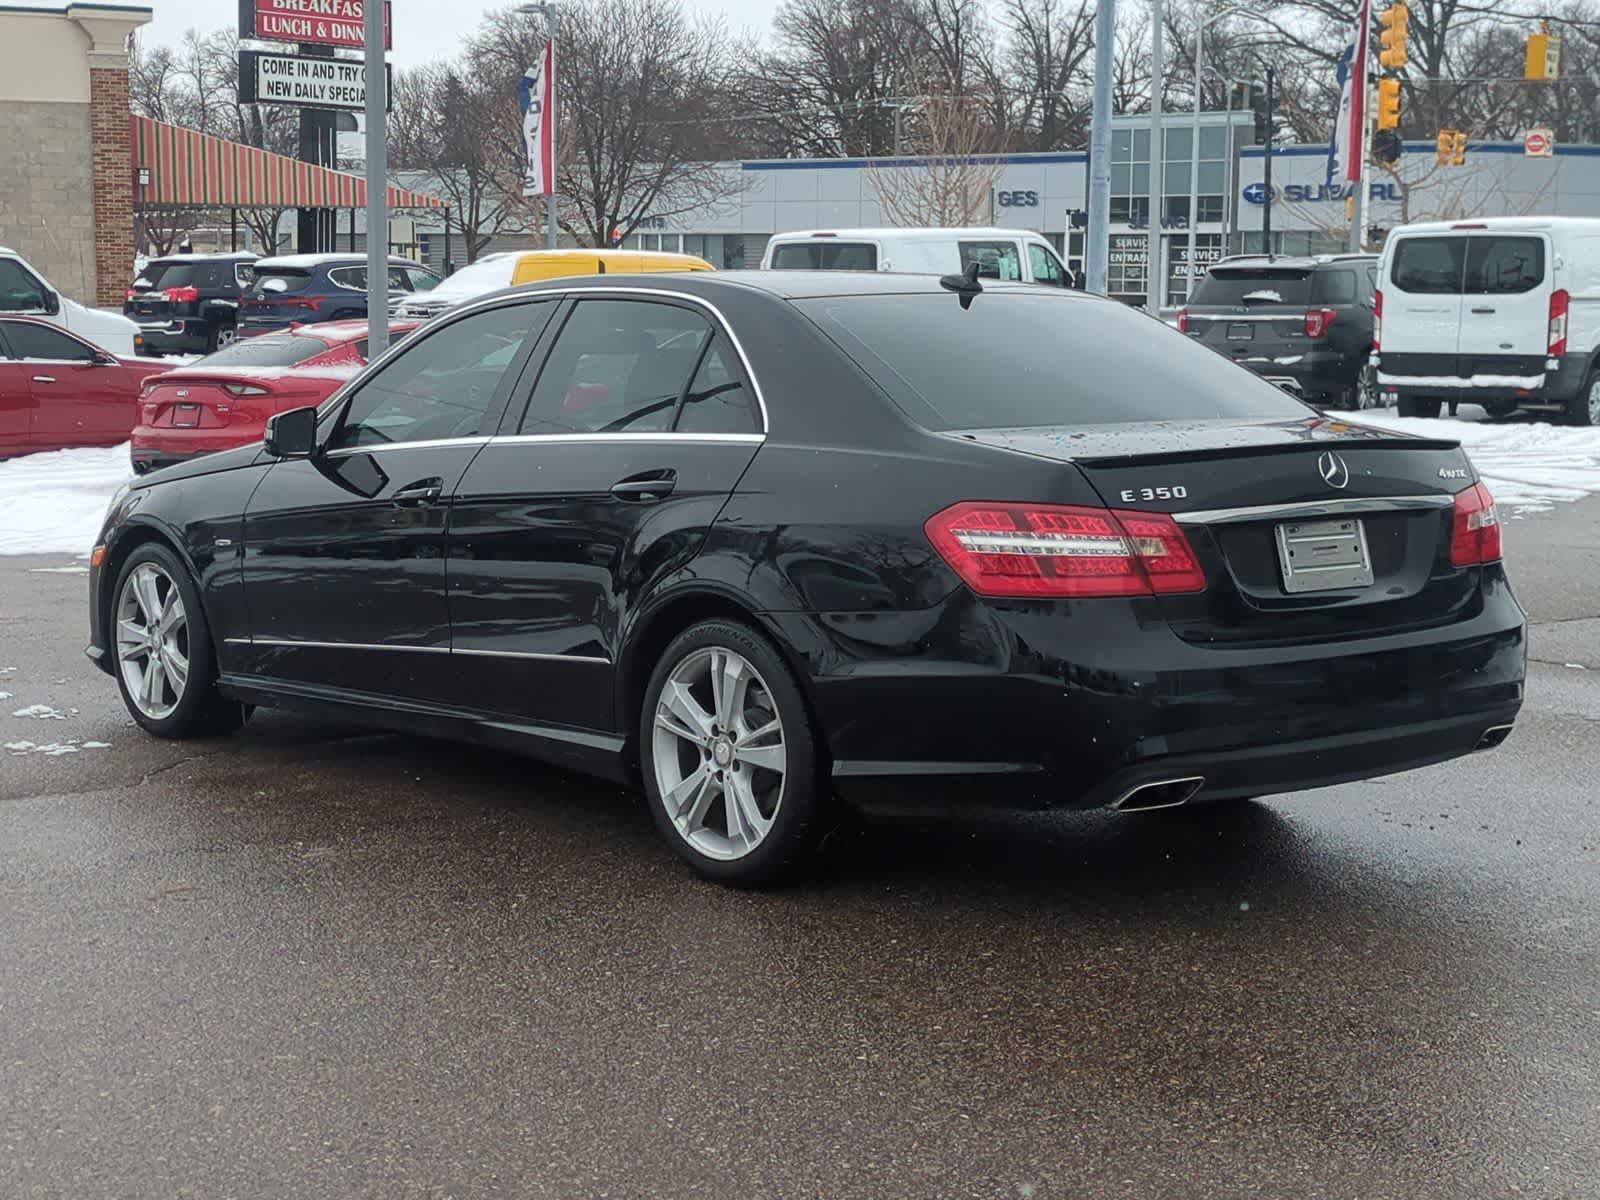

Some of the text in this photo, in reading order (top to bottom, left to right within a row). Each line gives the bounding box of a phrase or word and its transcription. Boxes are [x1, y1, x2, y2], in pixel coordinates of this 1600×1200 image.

[272, 0, 365, 18] BREAKFAS
[263, 15, 366, 41] LUNCH & DINN
[262, 59, 294, 76] COME
[297, 62, 309, 77] IN
[312, 64, 335, 79] AND
[338, 66, 359, 82] TRY
[267, 81, 366, 103] NEW DAILY SPECIA
[1128, 215, 1188, 230] SEVIC
[1115, 238, 1149, 249] SERVIC
[1110, 253, 1148, 263] ENTRAN
[1180, 250, 1220, 260] SVICE
[1120, 485, 1187, 502] E 350
